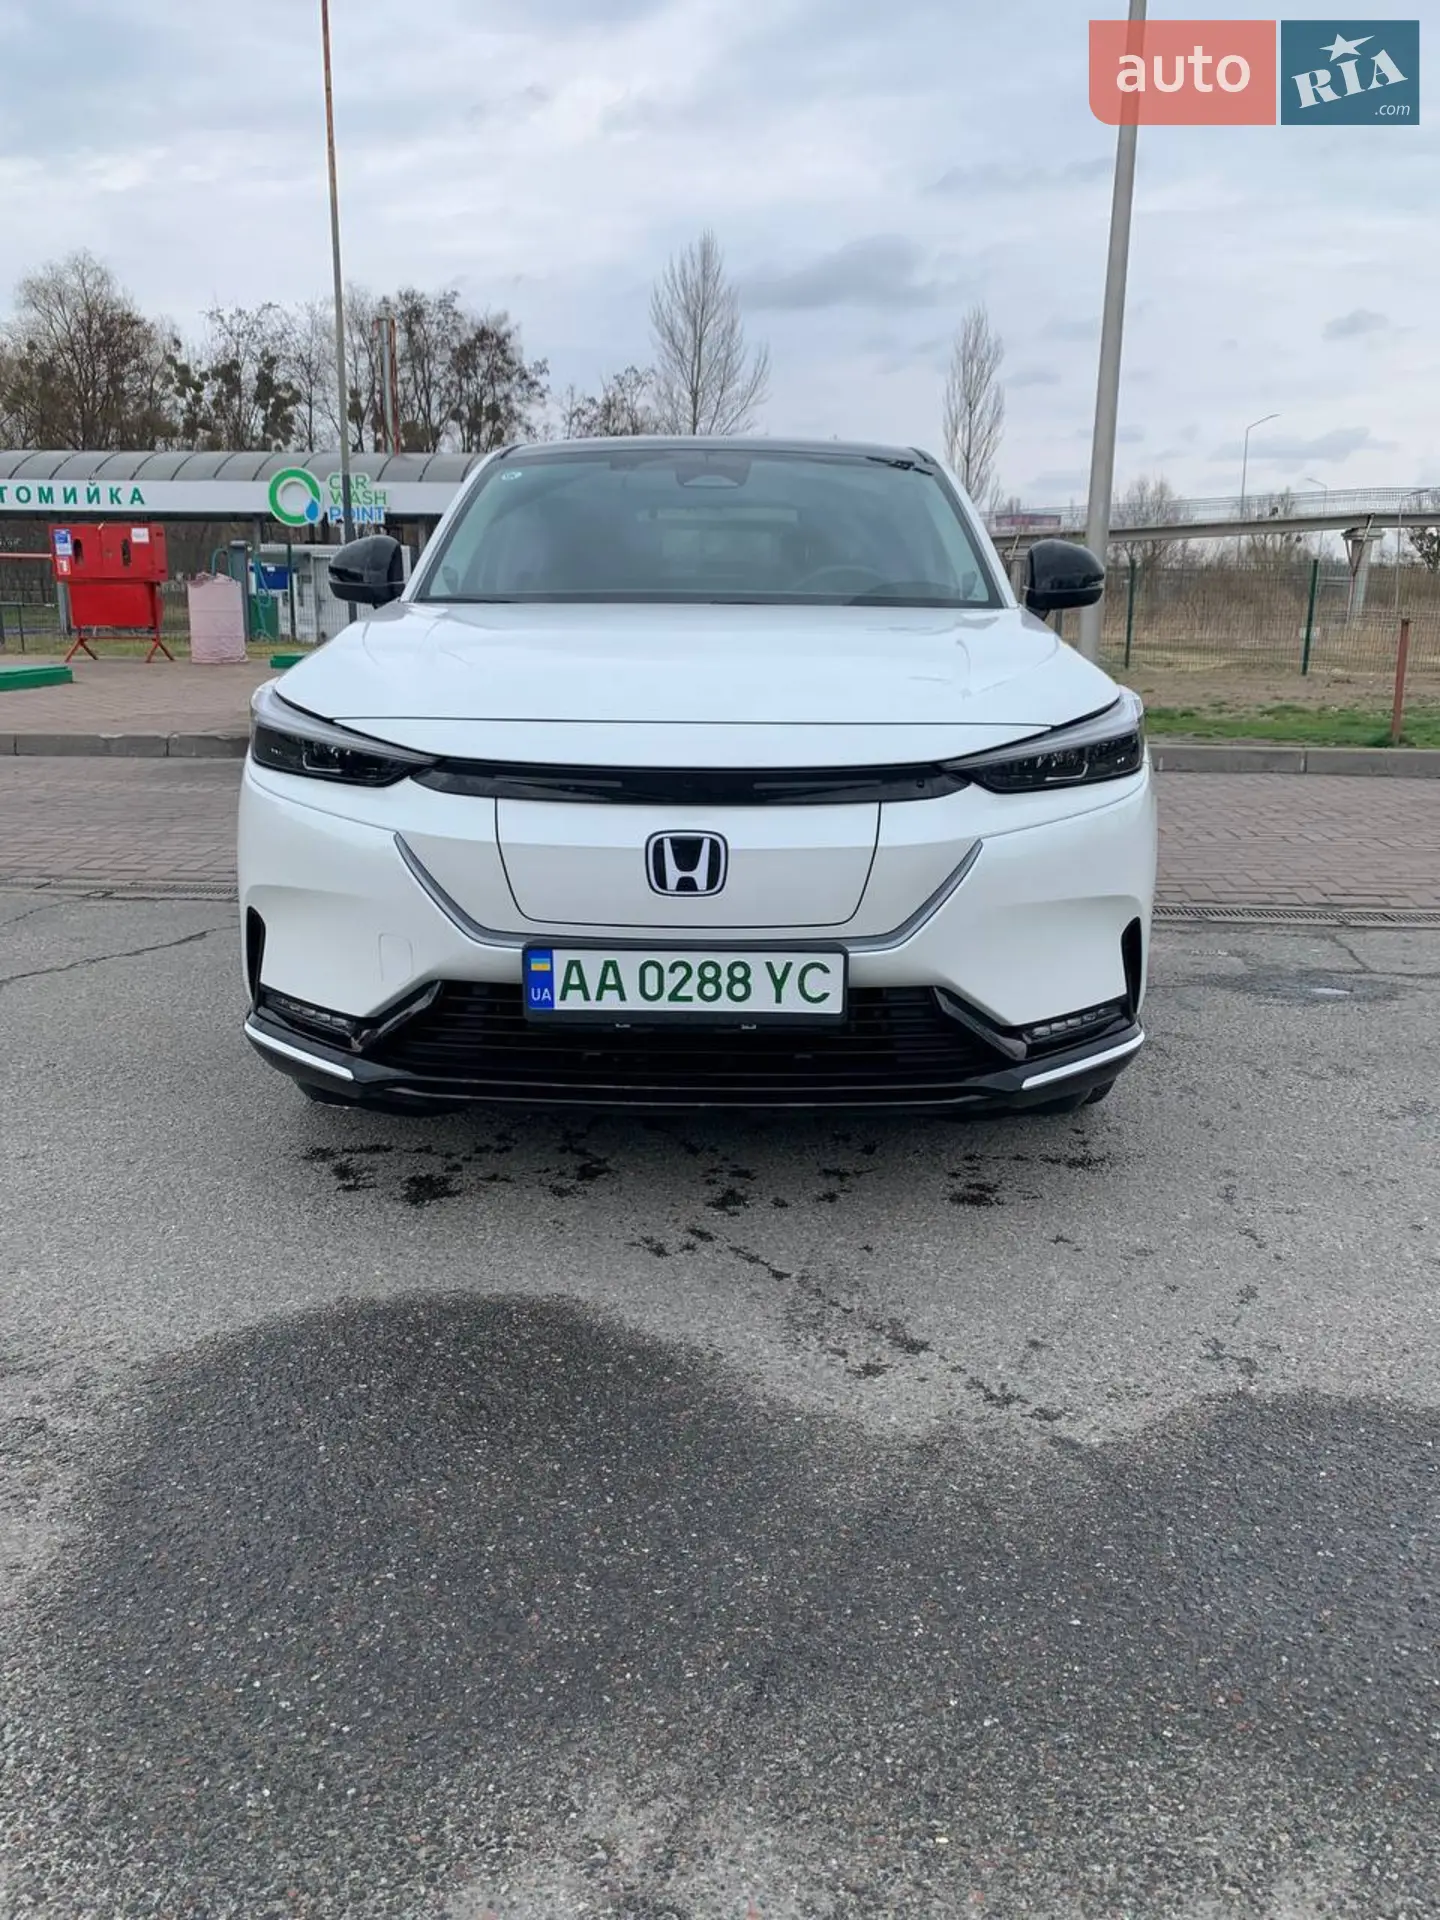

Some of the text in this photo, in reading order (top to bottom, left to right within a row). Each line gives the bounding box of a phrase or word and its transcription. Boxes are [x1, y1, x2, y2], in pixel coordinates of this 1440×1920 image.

[531, 987, 551, 1001] UA
[559, 959, 831, 1004] AA 0288 YC
